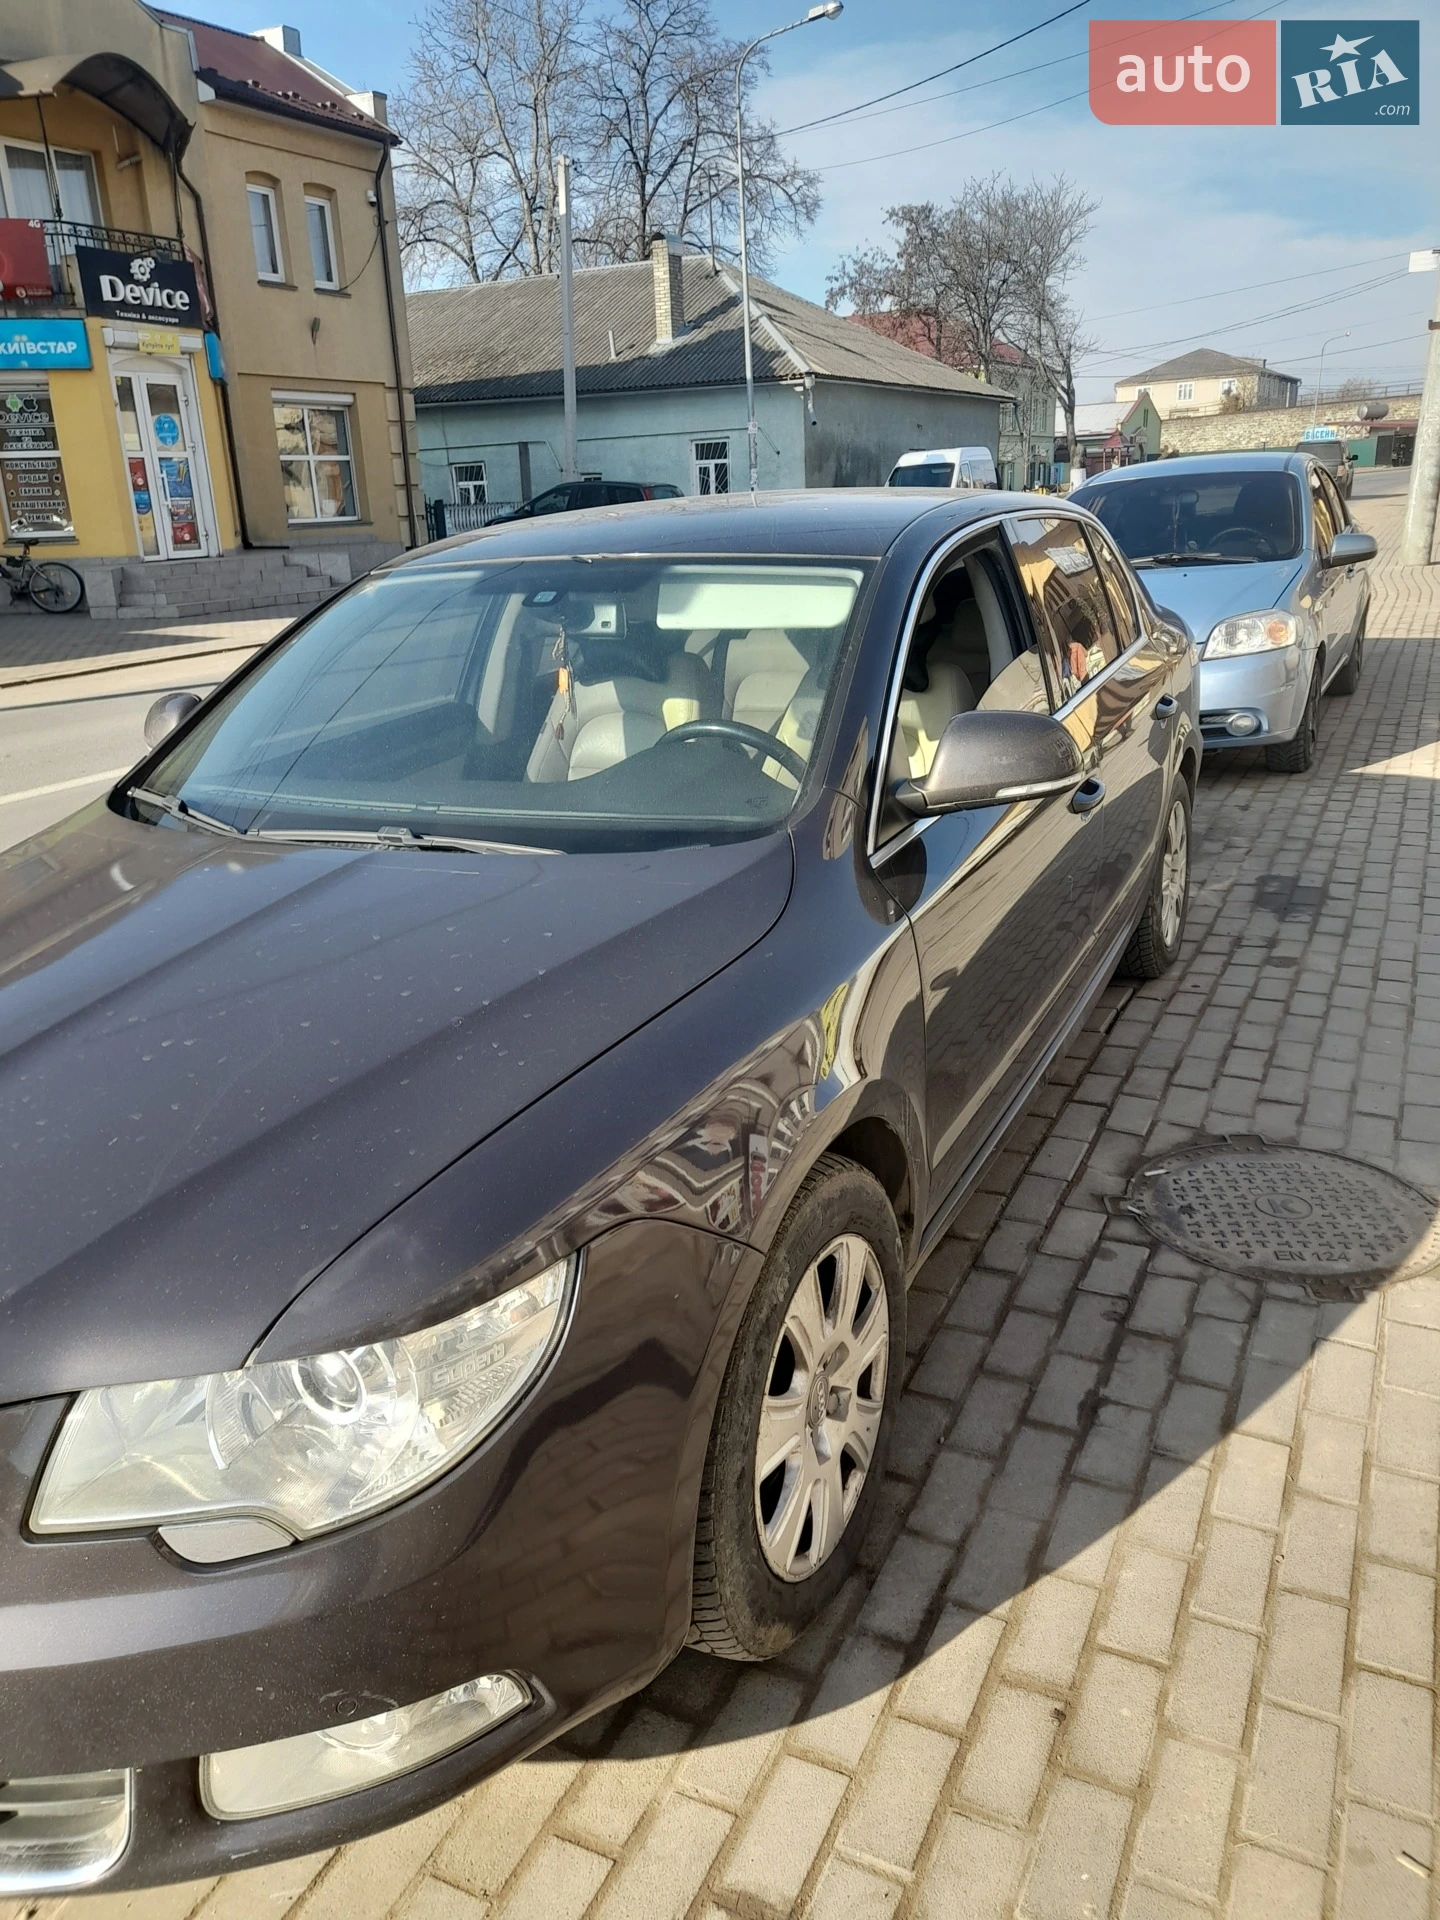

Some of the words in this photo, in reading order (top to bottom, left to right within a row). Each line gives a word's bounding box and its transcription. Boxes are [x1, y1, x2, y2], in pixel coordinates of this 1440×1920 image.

[28, 219, 41, 228] 4G
[99, 274, 190, 311] Device
[115, 310, 141, 319] Техніка
[0, 335, 77, 355] КИЇВСТАР
[4, 460, 58, 470] КОНСУЛЬТАЦІЯ
[17, 473, 49, 483] ПРОДАЖ
[19, 487, 52, 496] ГАРАНТІЯ
[10, 500, 66, 510] НАЛАШТУВАННЯ
[1273, 1250, 1307, 1261] EN
[1312, 1251, 1351, 1262] 124
